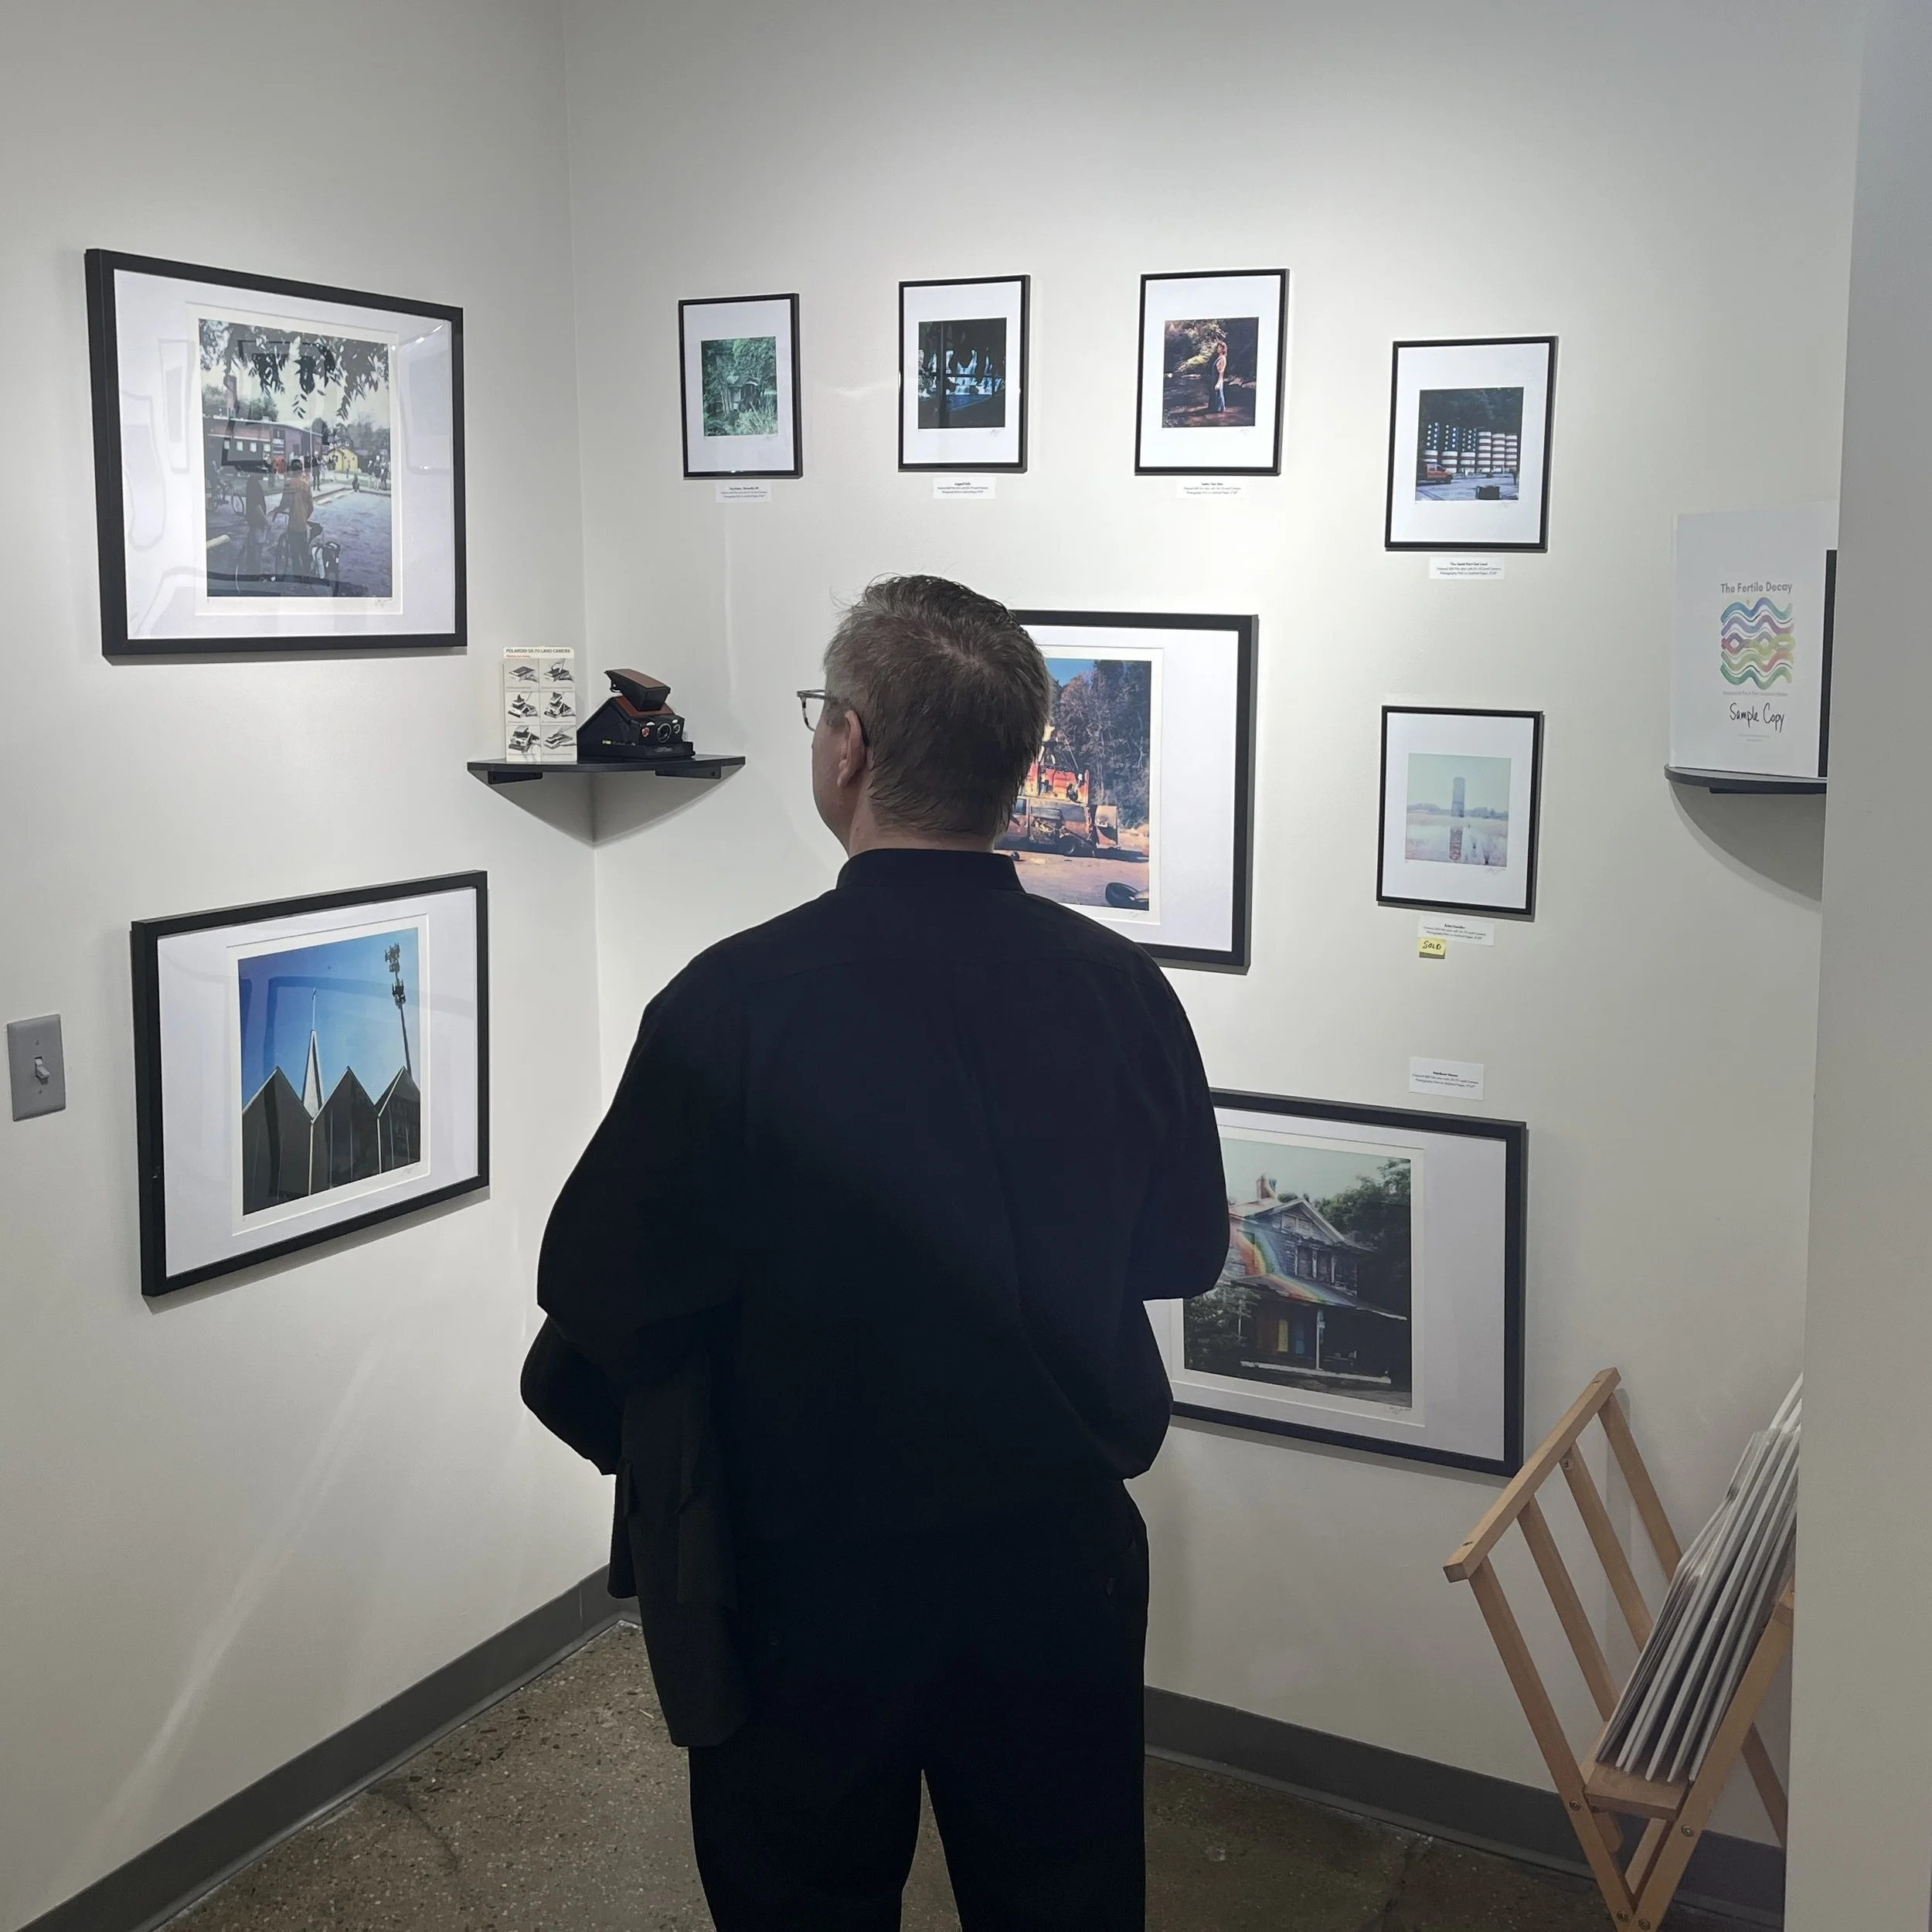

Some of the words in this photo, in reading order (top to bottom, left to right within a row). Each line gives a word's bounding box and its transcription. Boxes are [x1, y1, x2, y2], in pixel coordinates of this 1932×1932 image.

[1720, 583, 1736, 594] The
[1737, 582, 1764, 593] Fertile
[1766, 581, 1793, 594] Decay
[1730, 702, 1760, 728] Sample
[1763, 702, 1785, 733] Copy
[1423, 940, 1441, 950] SOLD
